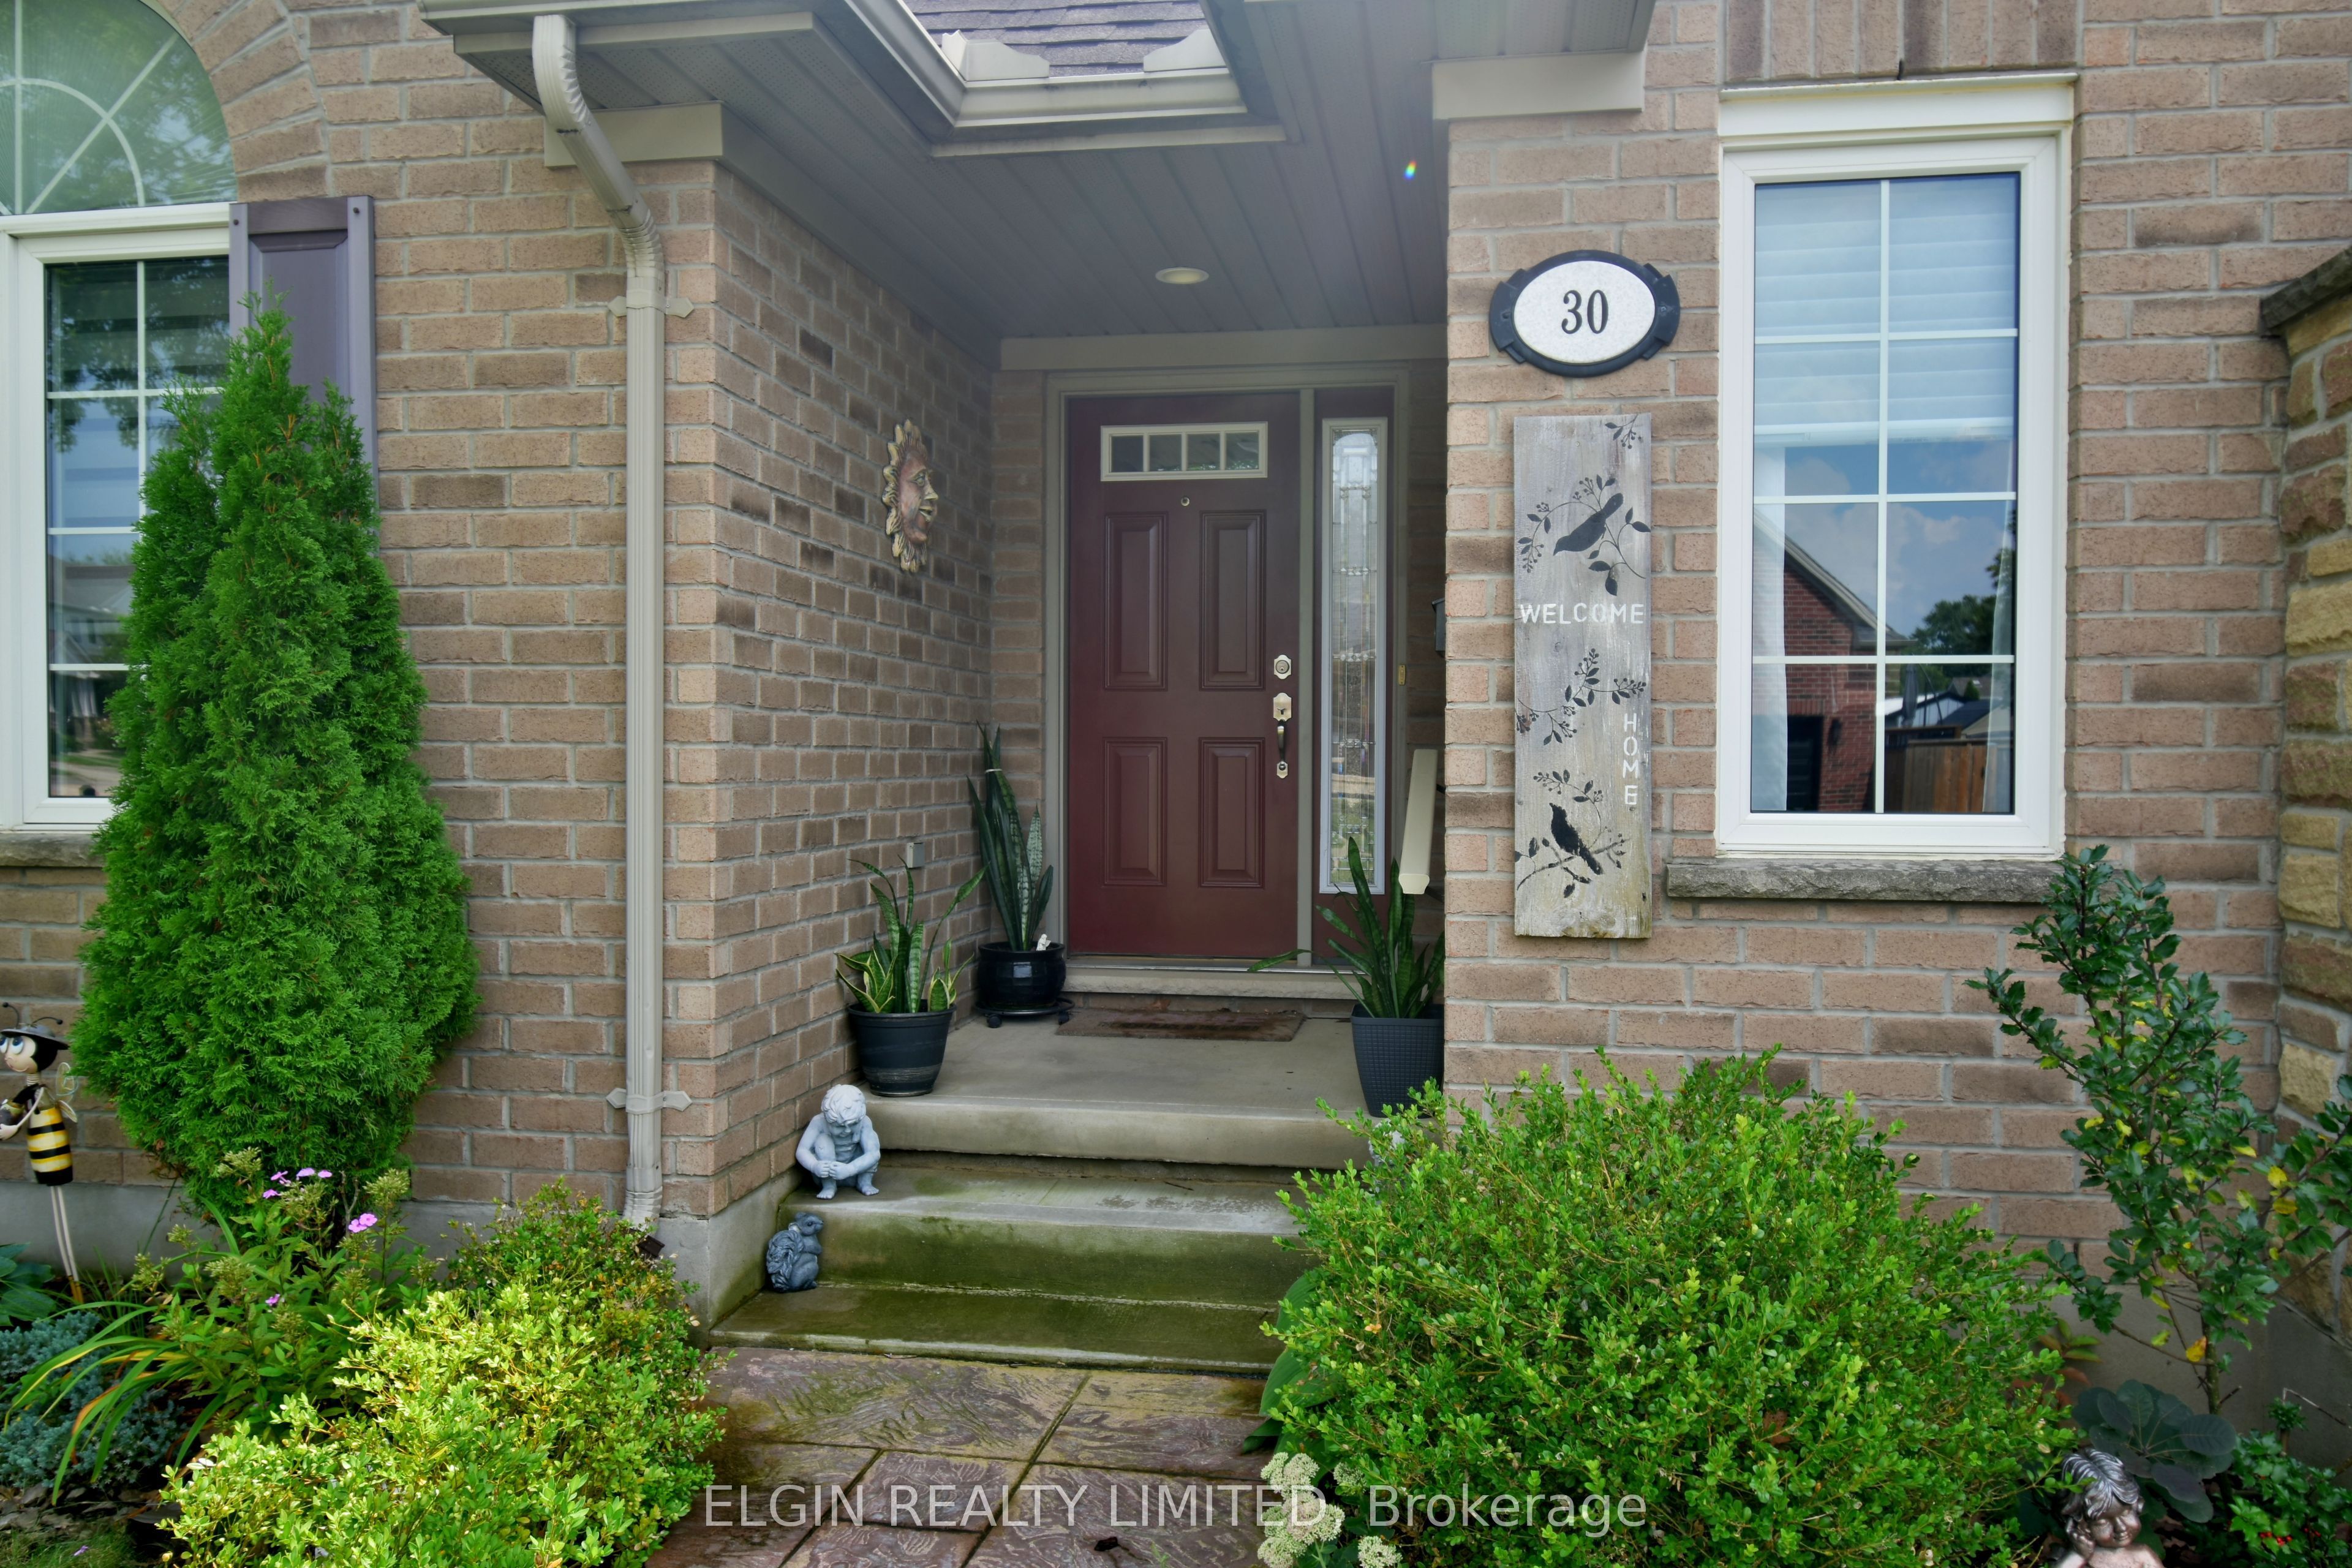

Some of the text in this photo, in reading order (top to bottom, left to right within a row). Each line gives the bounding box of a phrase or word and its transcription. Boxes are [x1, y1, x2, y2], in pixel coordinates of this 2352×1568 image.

[1561, 289, 1608, 334] 30
[1520, 603, 1644, 624] WELCOME
[1623, 713, 1641, 805] HOME
